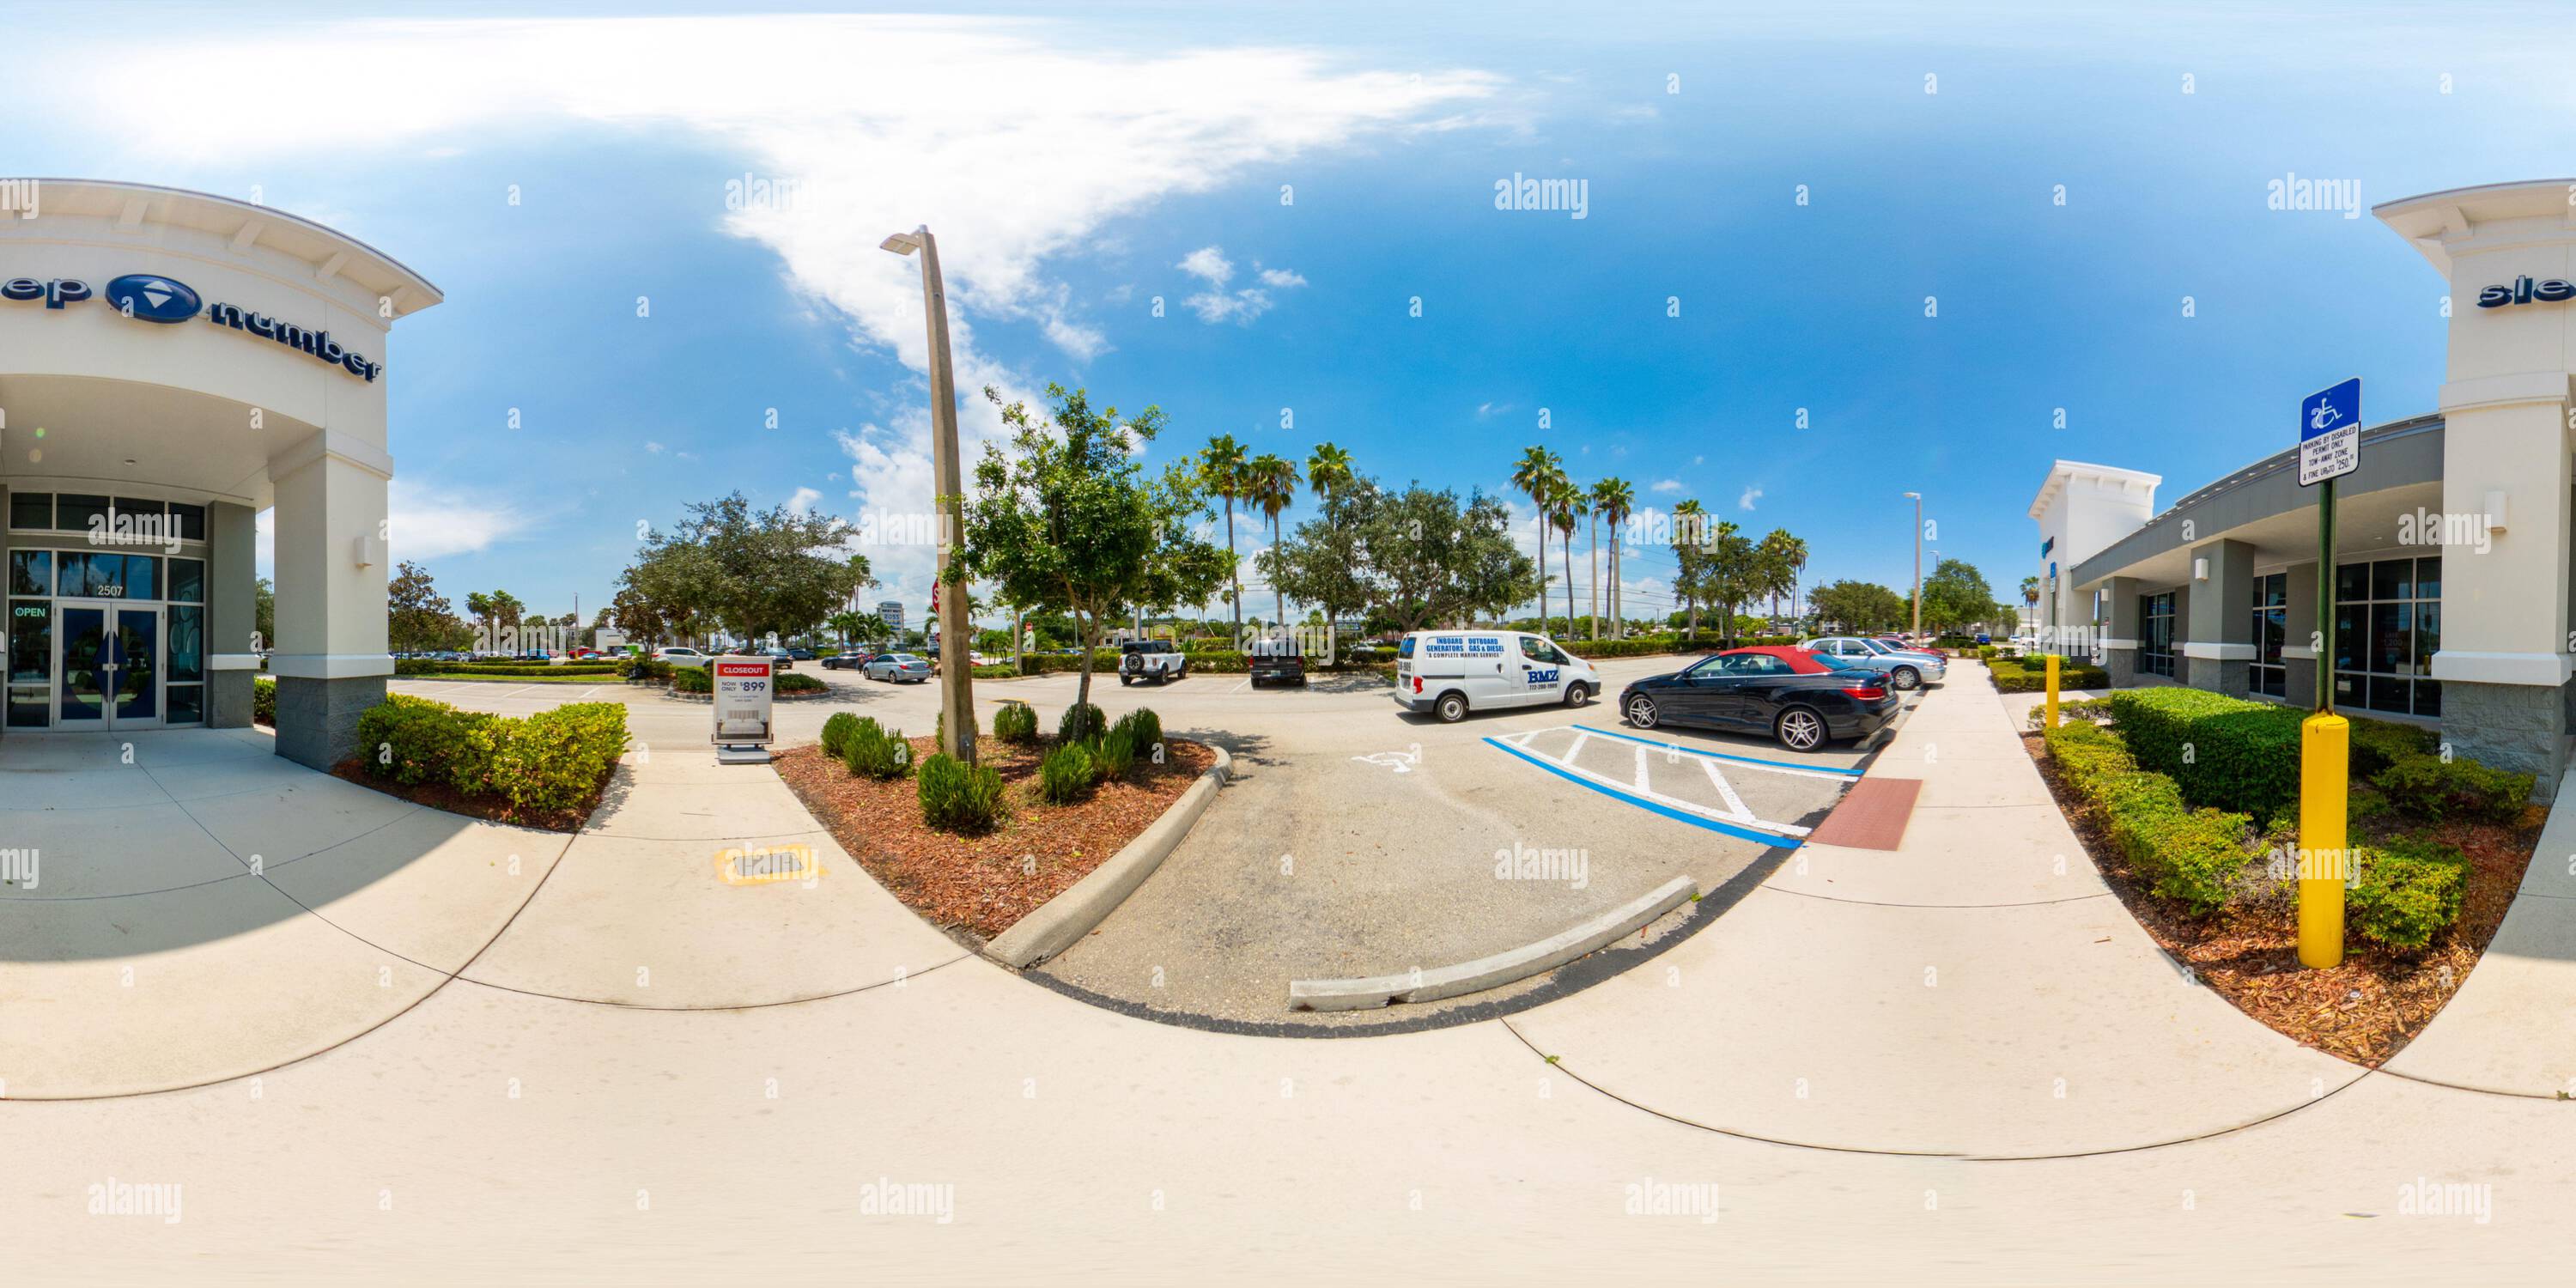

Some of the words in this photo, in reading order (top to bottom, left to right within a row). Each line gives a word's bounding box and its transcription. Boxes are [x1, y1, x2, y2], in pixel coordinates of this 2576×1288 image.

[2476, 274, 2576, 307] sle
[2, 277, 92, 309] ep
[212, 302, 381, 383] number
[2303, 438, 2322, 452] PARKING
[2330, 426, 2356, 440] DISABLED
[2312, 444, 2330, 456] PERMIT
[2331, 439, 2344, 449] ONLY
[2308, 453, 2333, 467] TOW-AWAY
[2335, 447, 2348, 458] ZONE
[2308, 469, 2318, 479] FINE
[2320, 466, 2327, 475] UP
[2328, 465, 2335, 473] TO
[98, 586, 123, 596] 2507
[15, 607, 46, 617] OPEN
[1528, 670, 1558, 683] BMZ
[739, 682, 766, 691] $899
